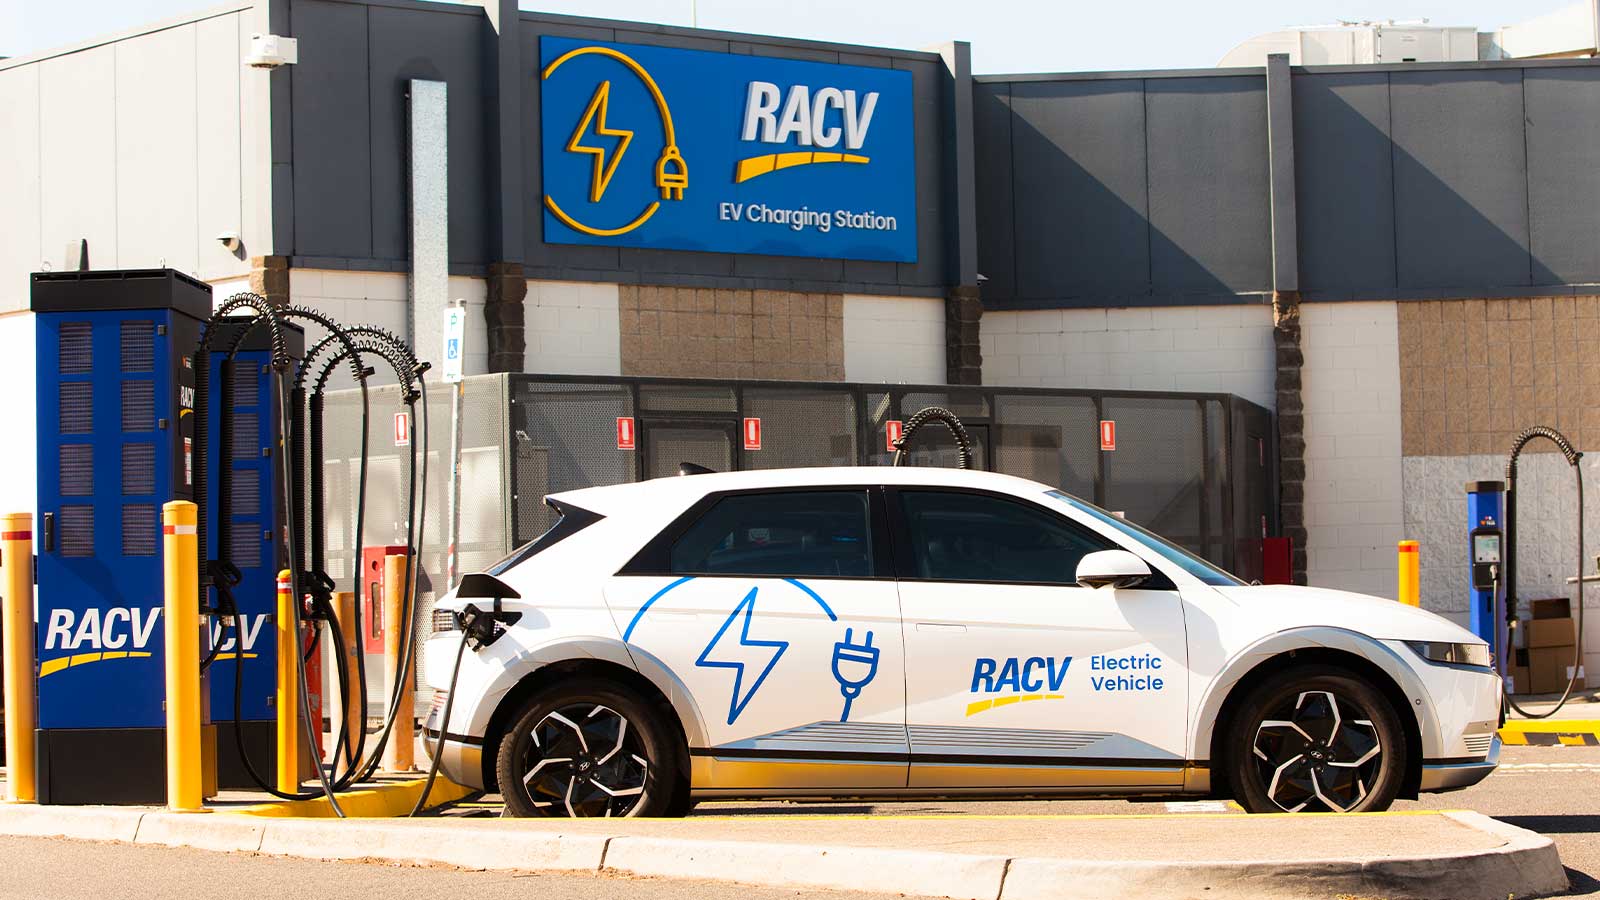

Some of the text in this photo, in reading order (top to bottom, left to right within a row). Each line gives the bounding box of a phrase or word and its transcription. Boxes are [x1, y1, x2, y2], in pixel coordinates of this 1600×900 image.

[741, 81, 880, 150] RACV
[719, 202, 897, 232] EV Charging Station
[180, 385, 195, 408] RACV
[44, 606, 162, 650] RACV
[208, 613, 267, 651] CV
[970, 653, 1162, 693] RACV Electric
[1090, 675, 1164, 691] Vehicle
